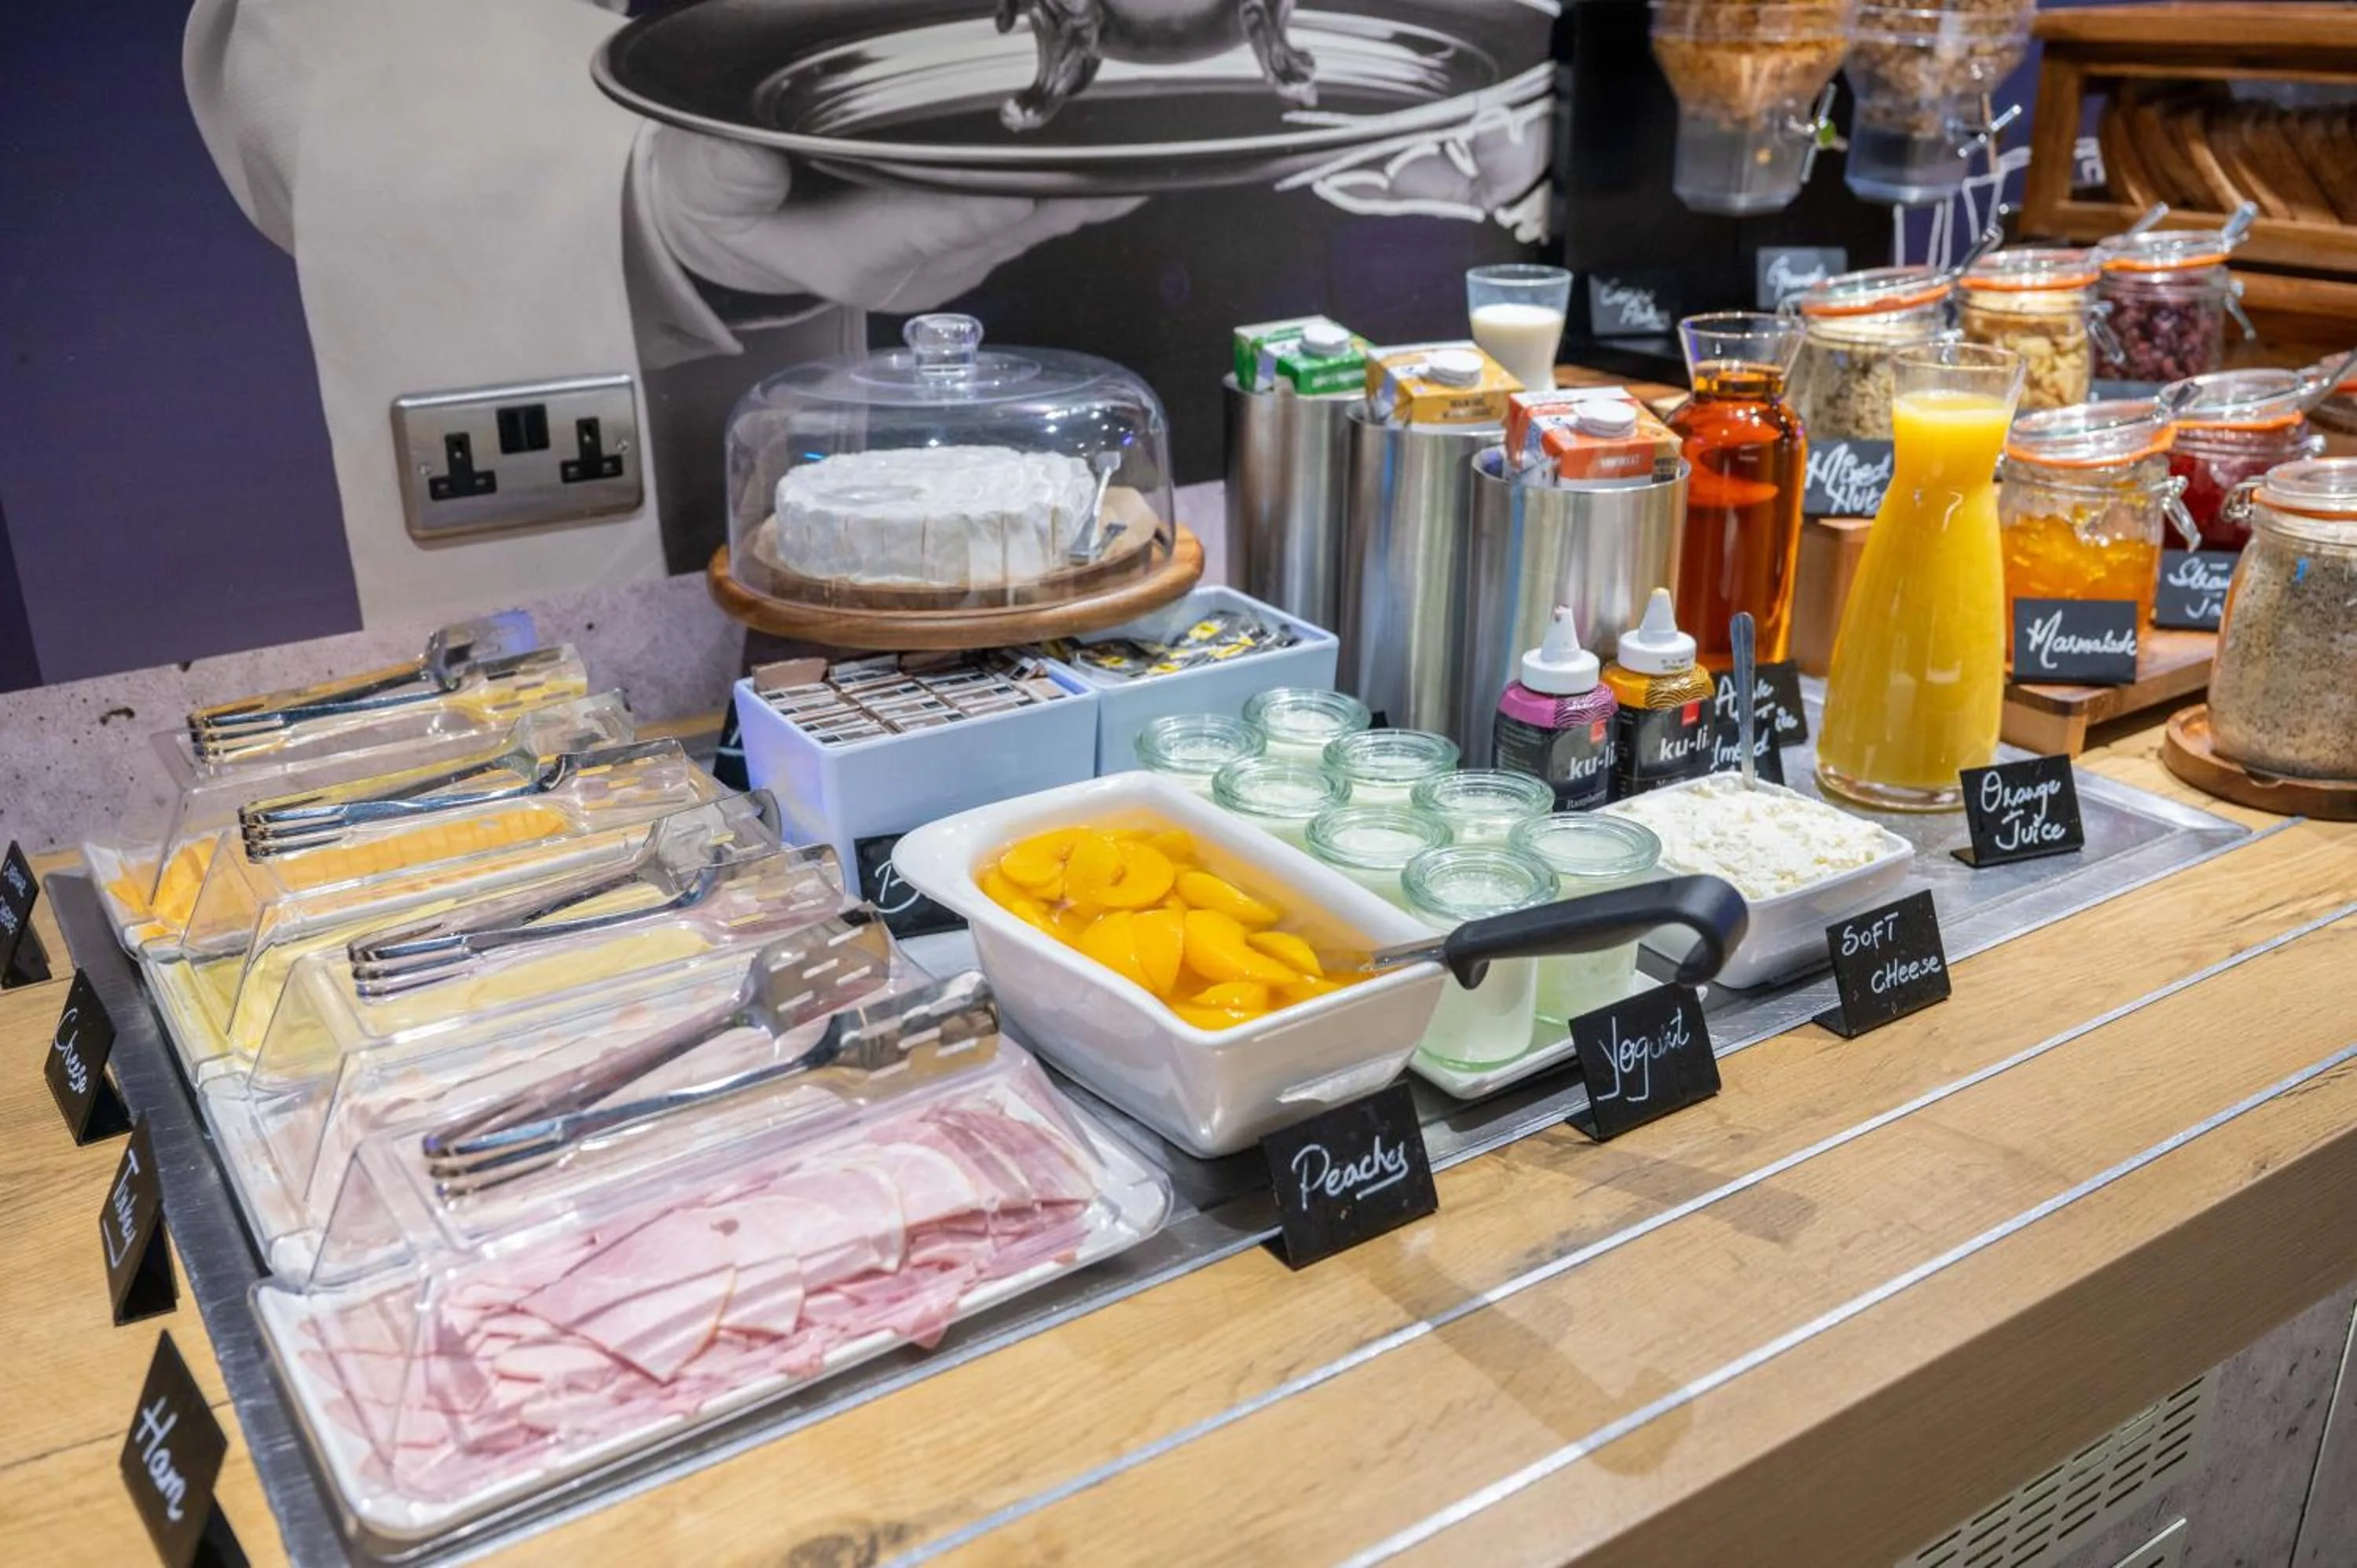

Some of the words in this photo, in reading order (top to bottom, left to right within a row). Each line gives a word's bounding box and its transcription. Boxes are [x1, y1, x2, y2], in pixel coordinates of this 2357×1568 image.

[2185, 591, 2223, 619] Ja
[2025, 608, 2137, 669] Marmalade
[1659, 724, 1708, 761] ku-li
[1981, 771, 2061, 821] Orange
[1995, 809, 2066, 850] Juice
[54, 1008, 87, 1094] Cheese
[134, 1395, 186, 1522] Ham
